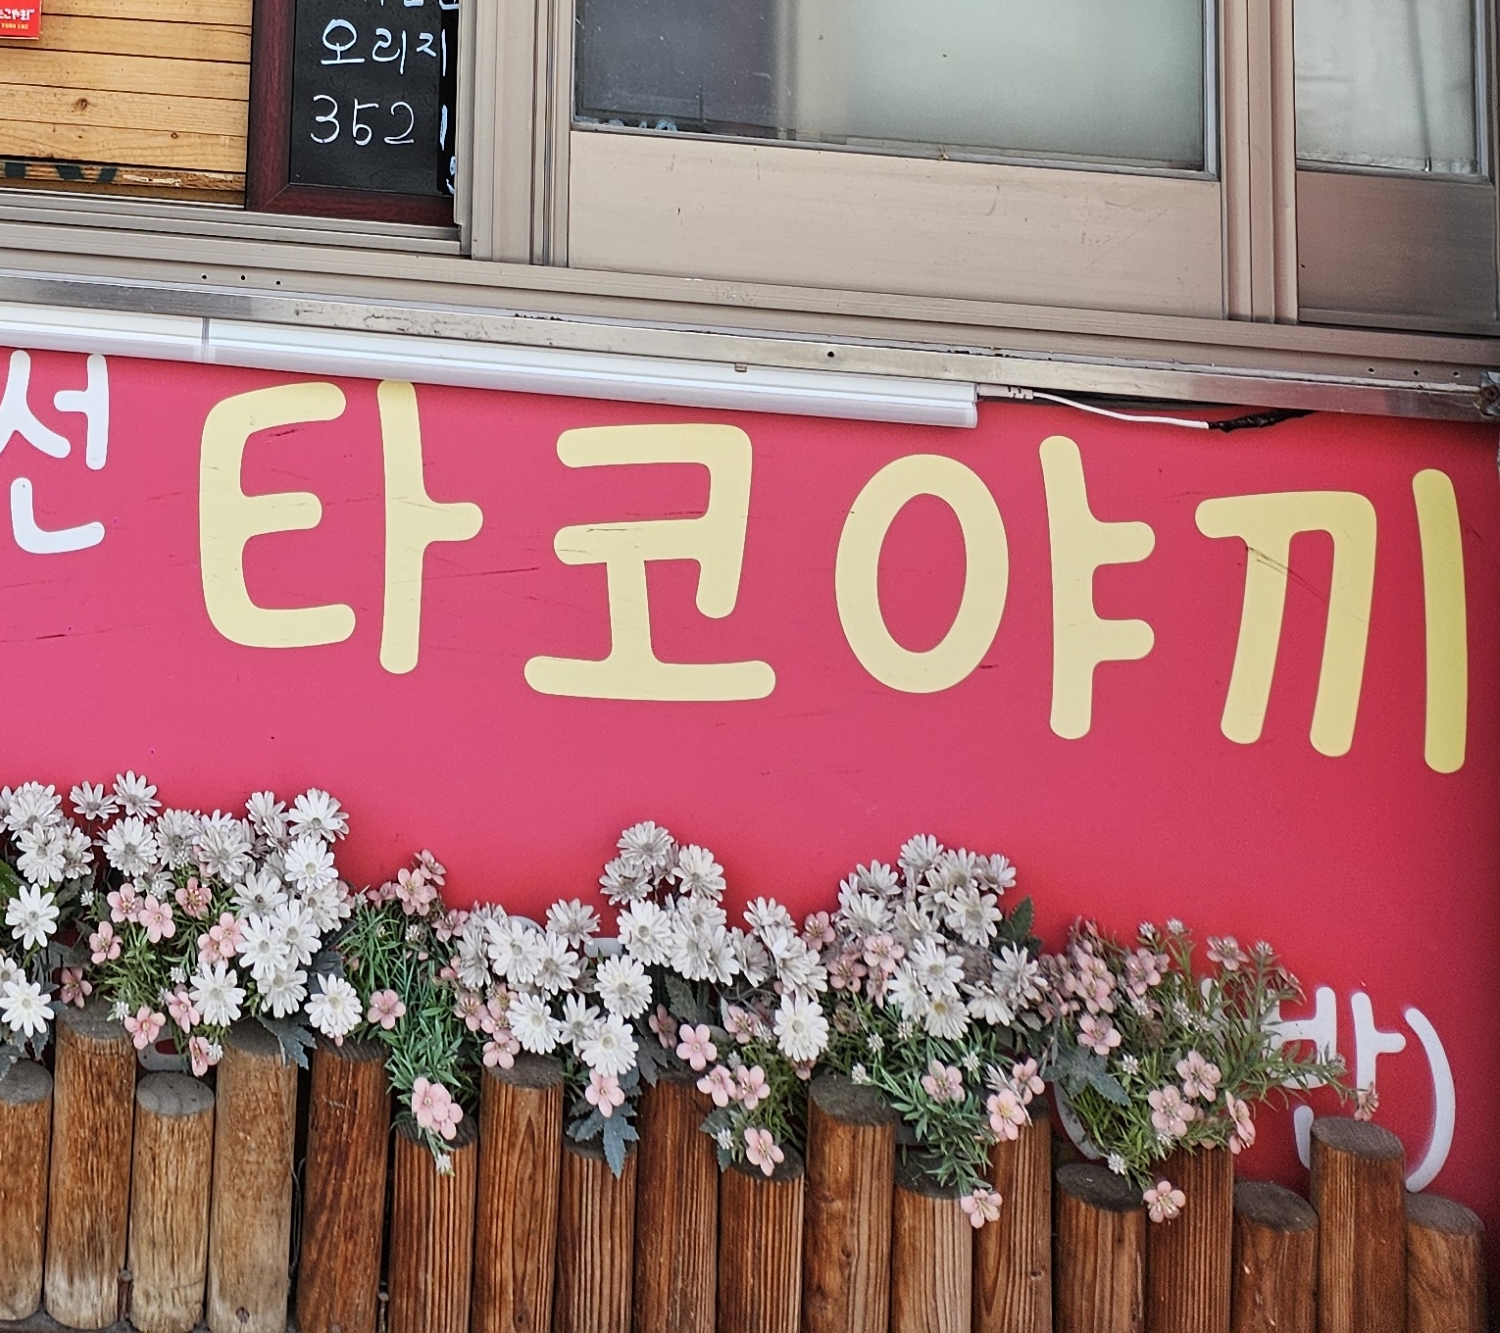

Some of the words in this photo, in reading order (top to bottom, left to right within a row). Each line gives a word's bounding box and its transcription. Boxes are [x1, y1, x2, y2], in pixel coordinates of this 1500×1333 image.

[320, 19, 447, 77] 오리지
[310, 94, 414, 146] 352
[198, 379, 1469, 774] 타코야끼
